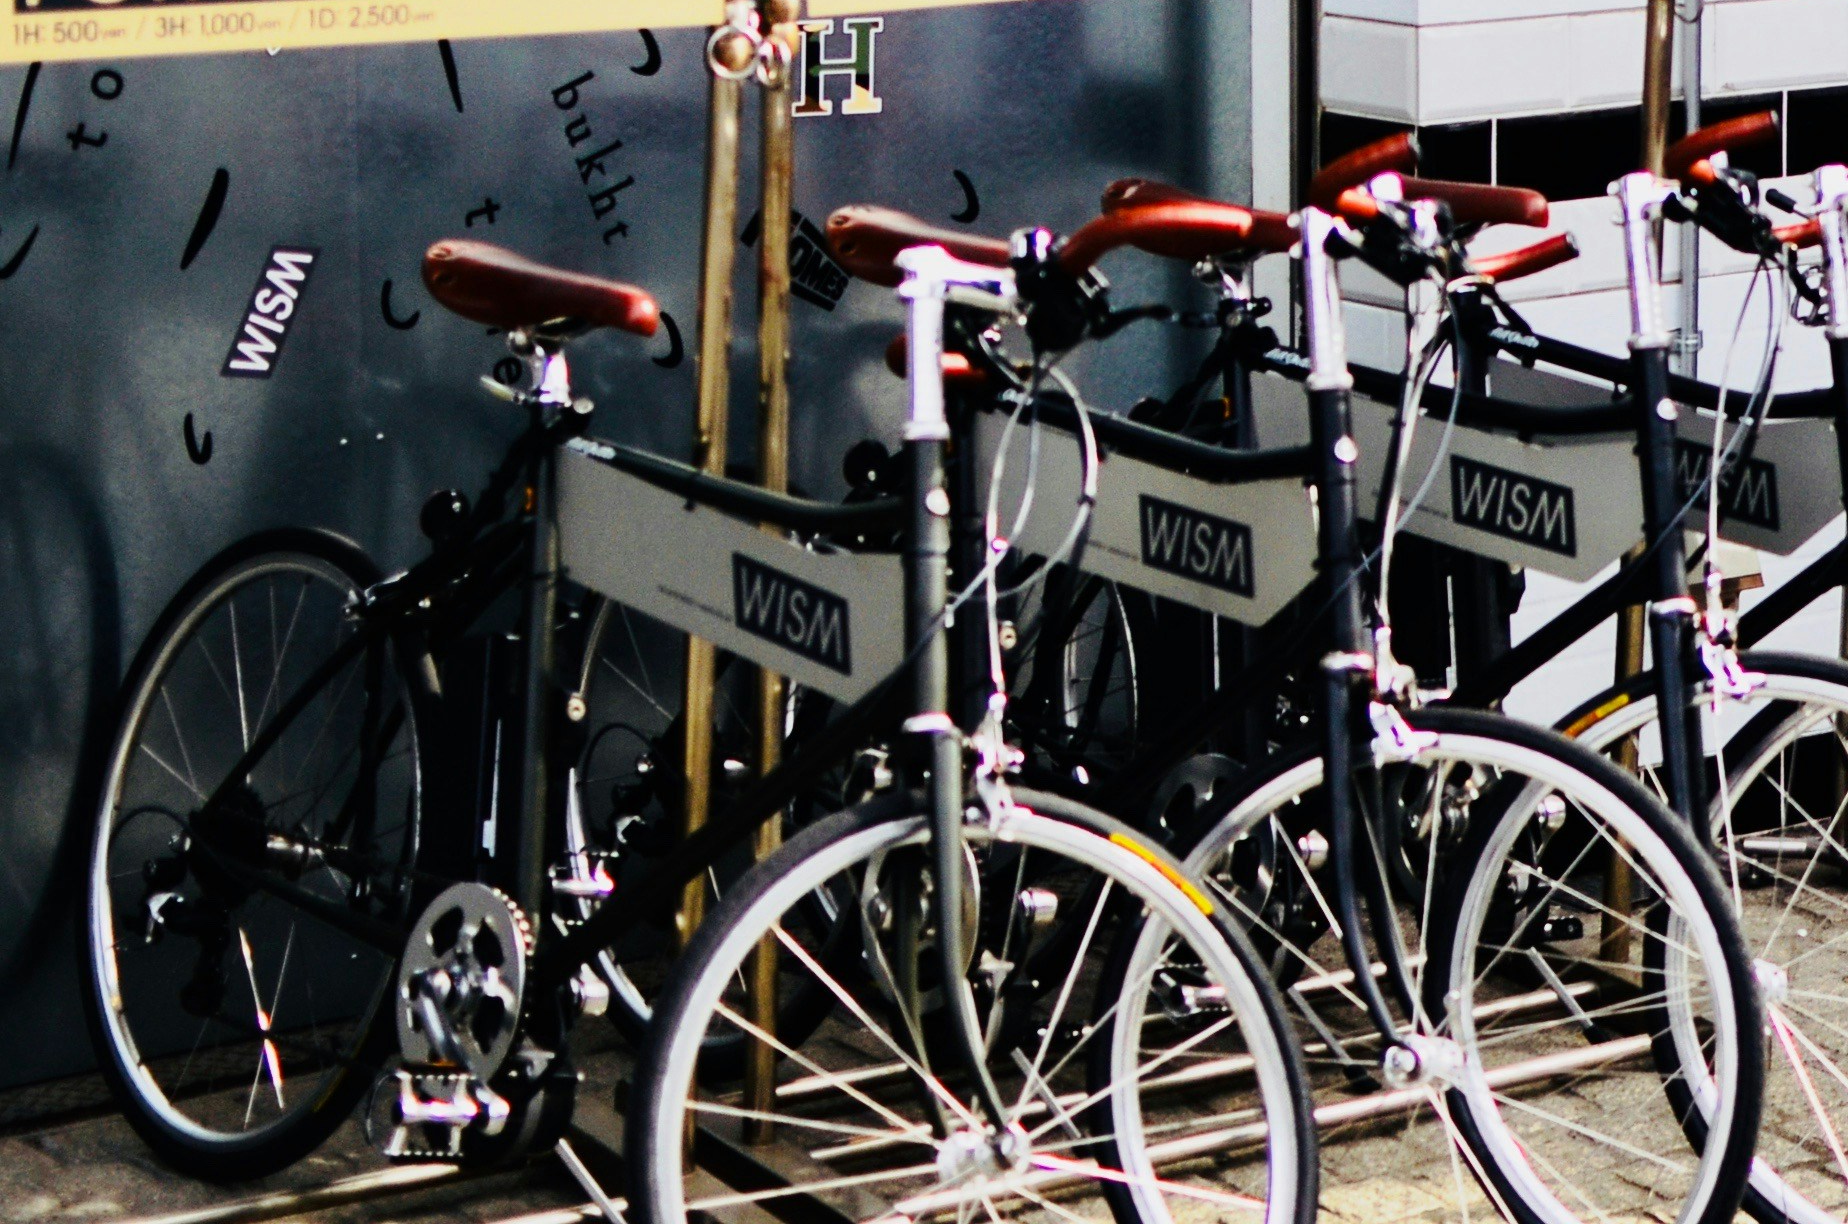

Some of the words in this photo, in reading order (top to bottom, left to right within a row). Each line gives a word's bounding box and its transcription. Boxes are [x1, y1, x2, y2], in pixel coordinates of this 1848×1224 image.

[792, 18, 884, 117] H
[229, 251, 314, 371] WISM
[1147, 505, 1246, 587] WISM
[1459, 465, 1567, 556] WISM
[741, 565, 843, 663] WISM
